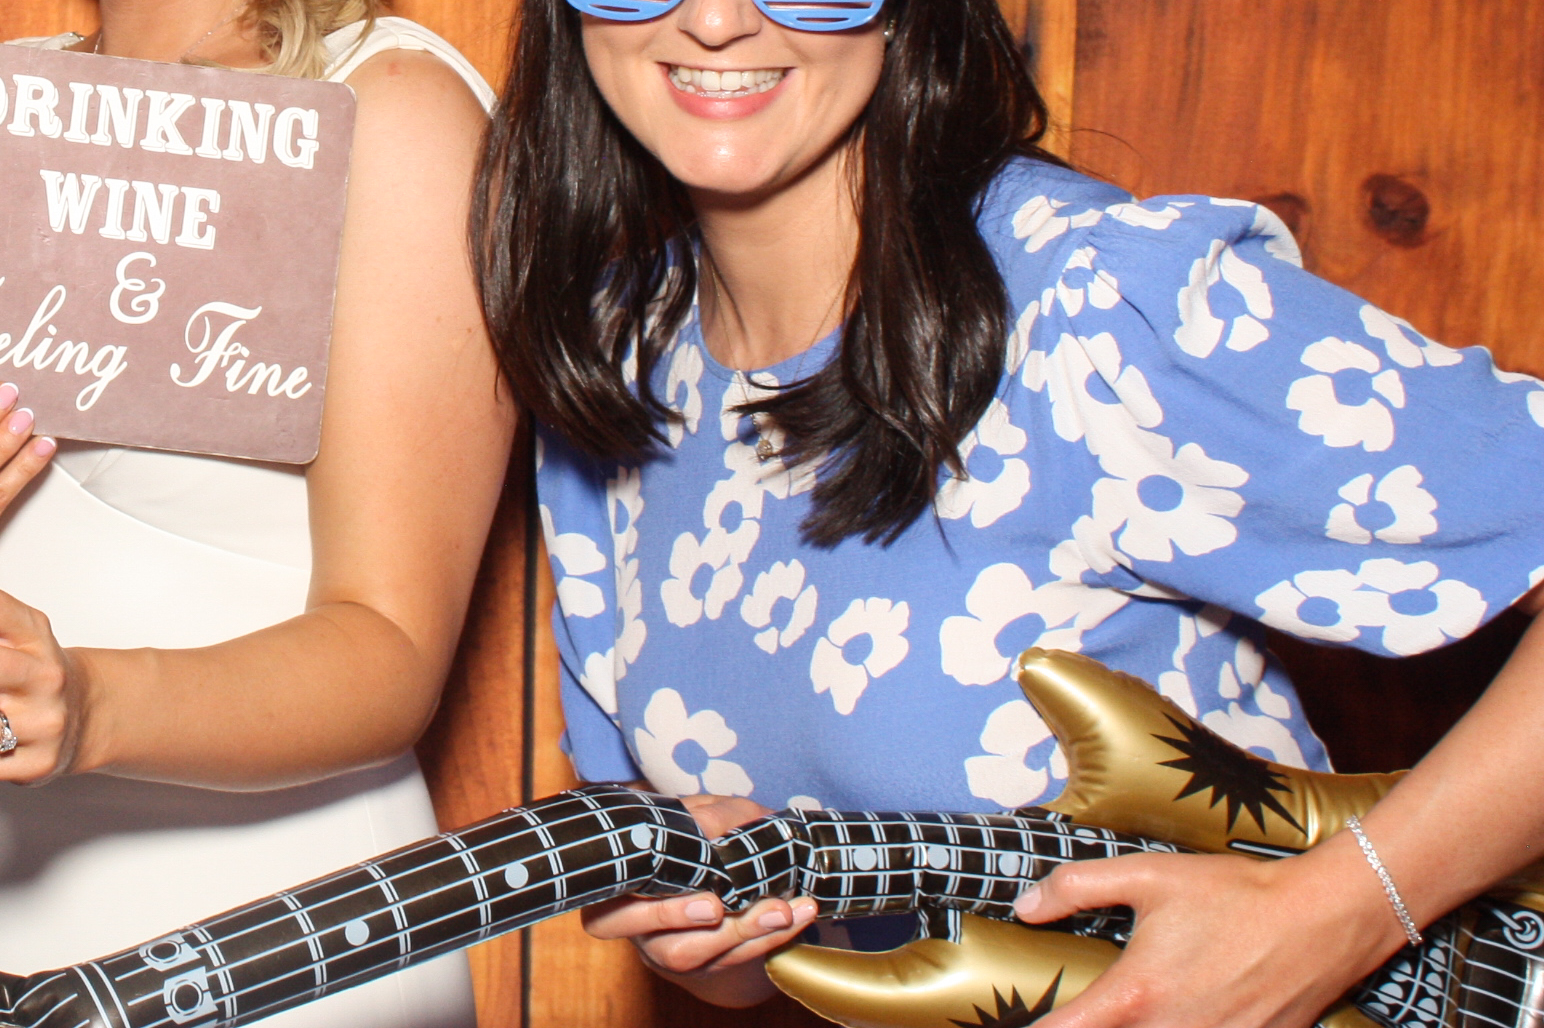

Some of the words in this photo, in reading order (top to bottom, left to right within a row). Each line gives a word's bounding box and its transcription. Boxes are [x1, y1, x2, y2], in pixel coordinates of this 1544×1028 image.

[39, 168, 221, 250] WINE
[108, 251, 166, 325] &
[169, 300, 313, 400] Fine
